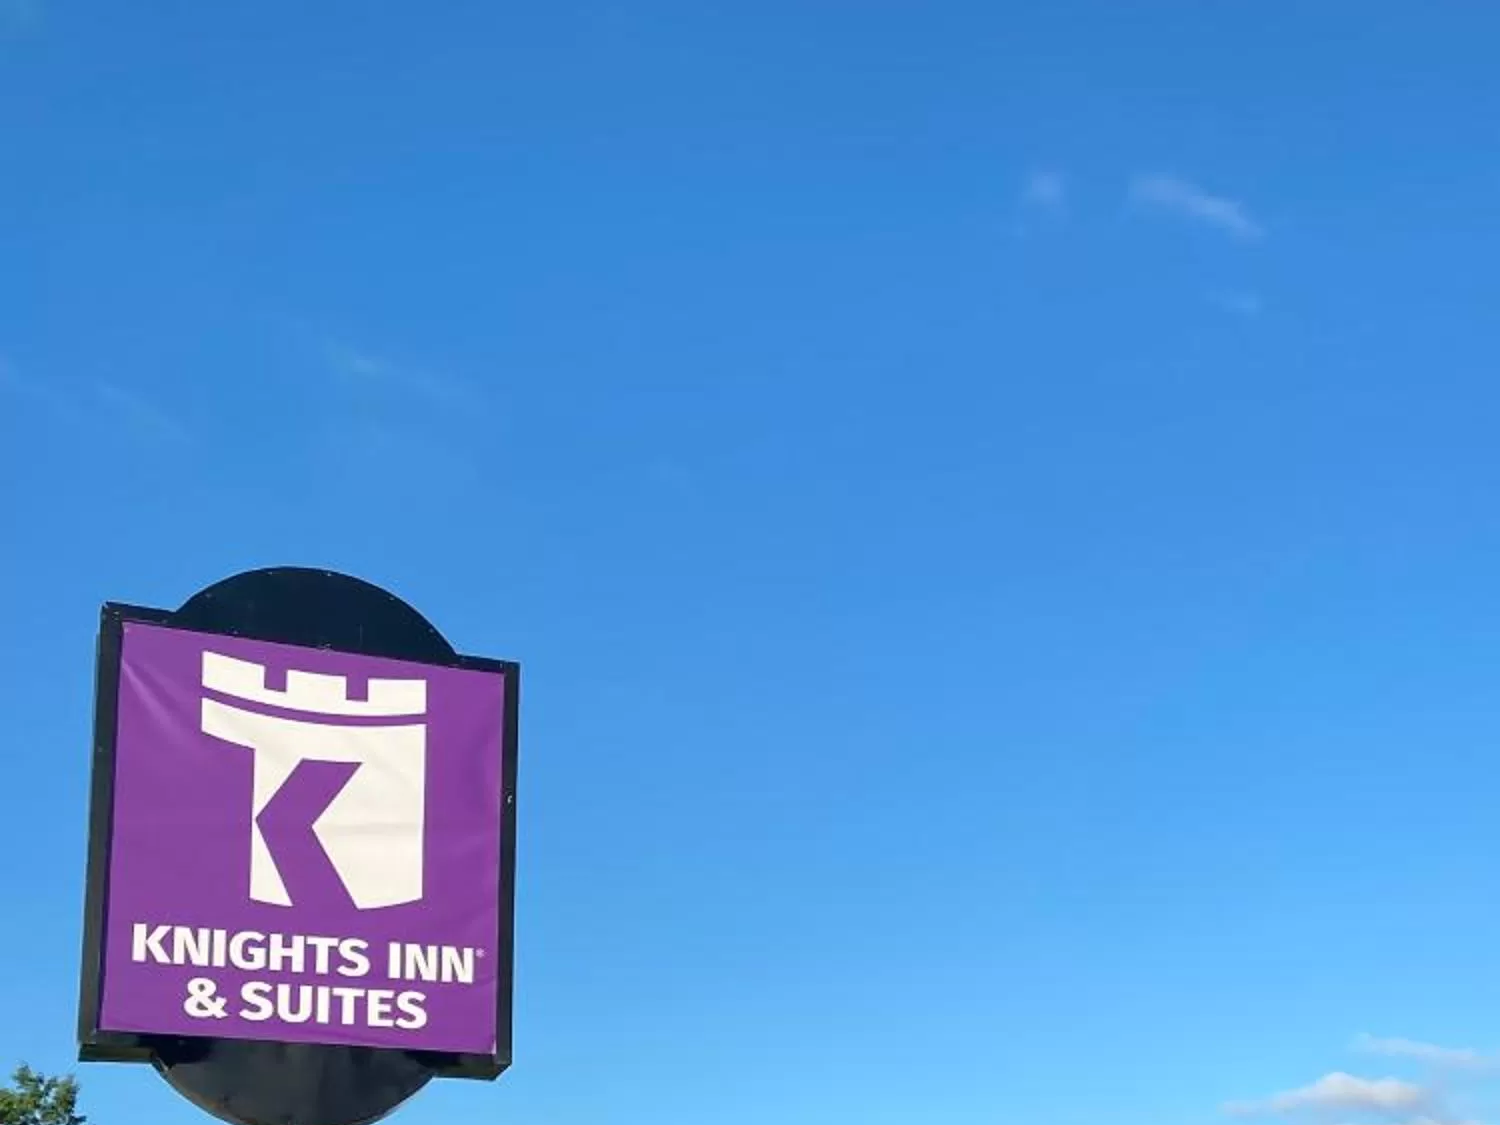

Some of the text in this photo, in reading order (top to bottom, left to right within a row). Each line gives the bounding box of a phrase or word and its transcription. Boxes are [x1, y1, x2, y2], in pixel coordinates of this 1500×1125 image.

[131, 922, 372, 978] KNIGHTS
[183, 977, 428, 1030] & SUITES
